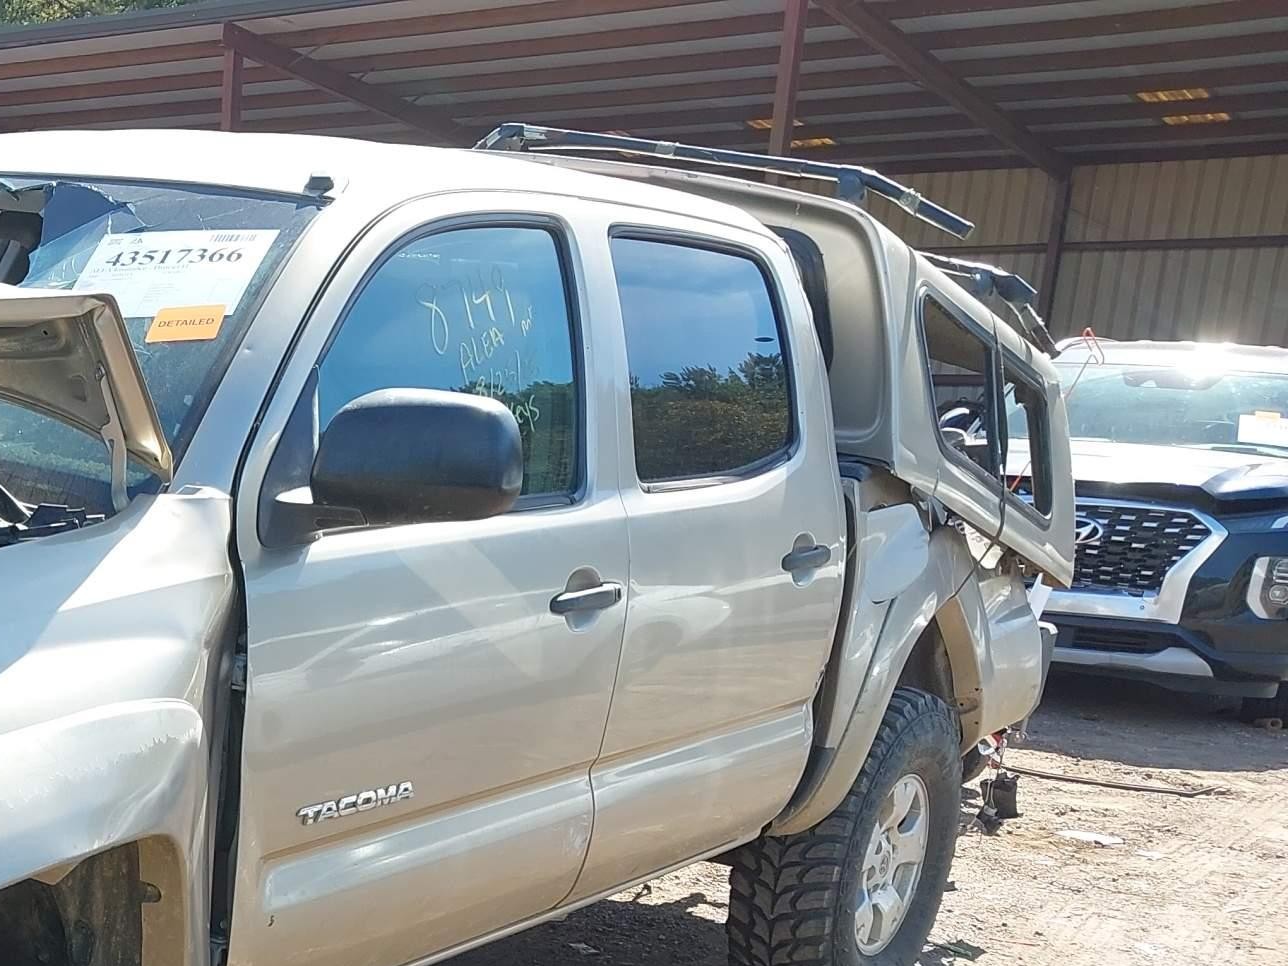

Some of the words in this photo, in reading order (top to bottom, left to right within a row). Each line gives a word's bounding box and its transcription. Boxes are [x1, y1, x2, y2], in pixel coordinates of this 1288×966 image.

[105, 247, 243, 267] 43517366
[158, 317, 215, 329] DETAILED
[296, 780, 416, 826] TACOMA
